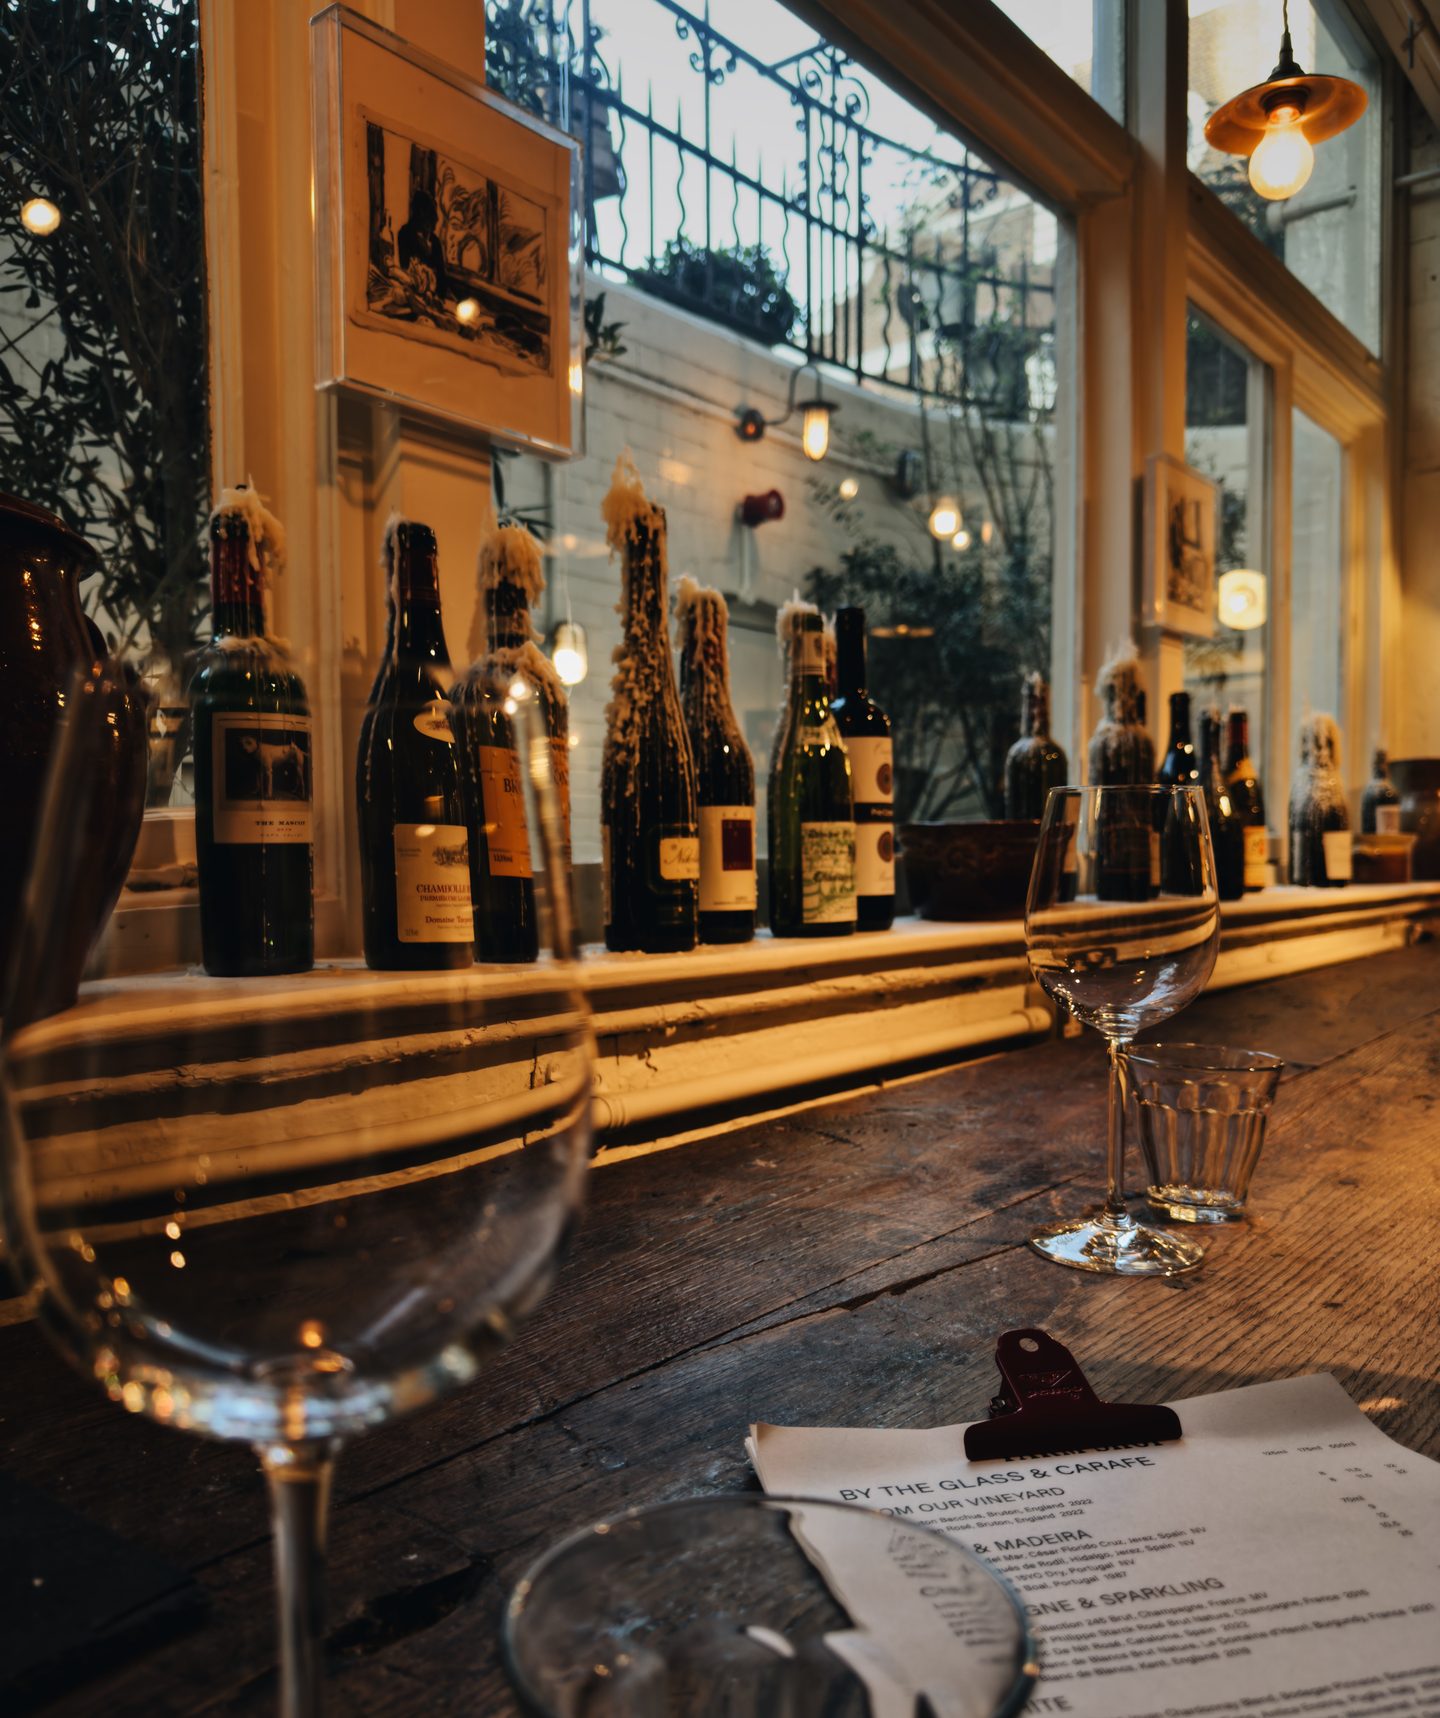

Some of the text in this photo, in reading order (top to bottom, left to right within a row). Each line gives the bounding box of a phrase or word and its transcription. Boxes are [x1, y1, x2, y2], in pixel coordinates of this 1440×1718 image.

[840, 1456, 1156, 1501] BY THE GLASS & CARAFE
[880, 1487, 1065, 1518] OM OUR VINEYARD
[939, 1511, 985, 1524] Bacchus,
[986, 1506, 1024, 1519] Bruton,
[1025, 1501, 1065, 1515] England
[1069, 1499, 1093, 1508] 2022
[976, 1518, 1012, 1530] Bruton,
[1015, 1513, 1056, 1527] England
[1060, 1508, 1086, 1517] 2022
[973, 1529, 1092, 1553] & MADEIRA
[1157, 1528, 1187, 1541] Spain
[1144, 1541, 1175, 1553] Spain
[1068, 1561, 1115, 1576] Portugal
[1052, 1574, 1099, 1589] Portugal
[1078, 1596, 1096, 1610] &
[1099, 1576, 1225, 1607] SPARKLING
[1137, 1601, 1206, 1620] Champagne,
[1207, 1595, 1247, 1608] France
